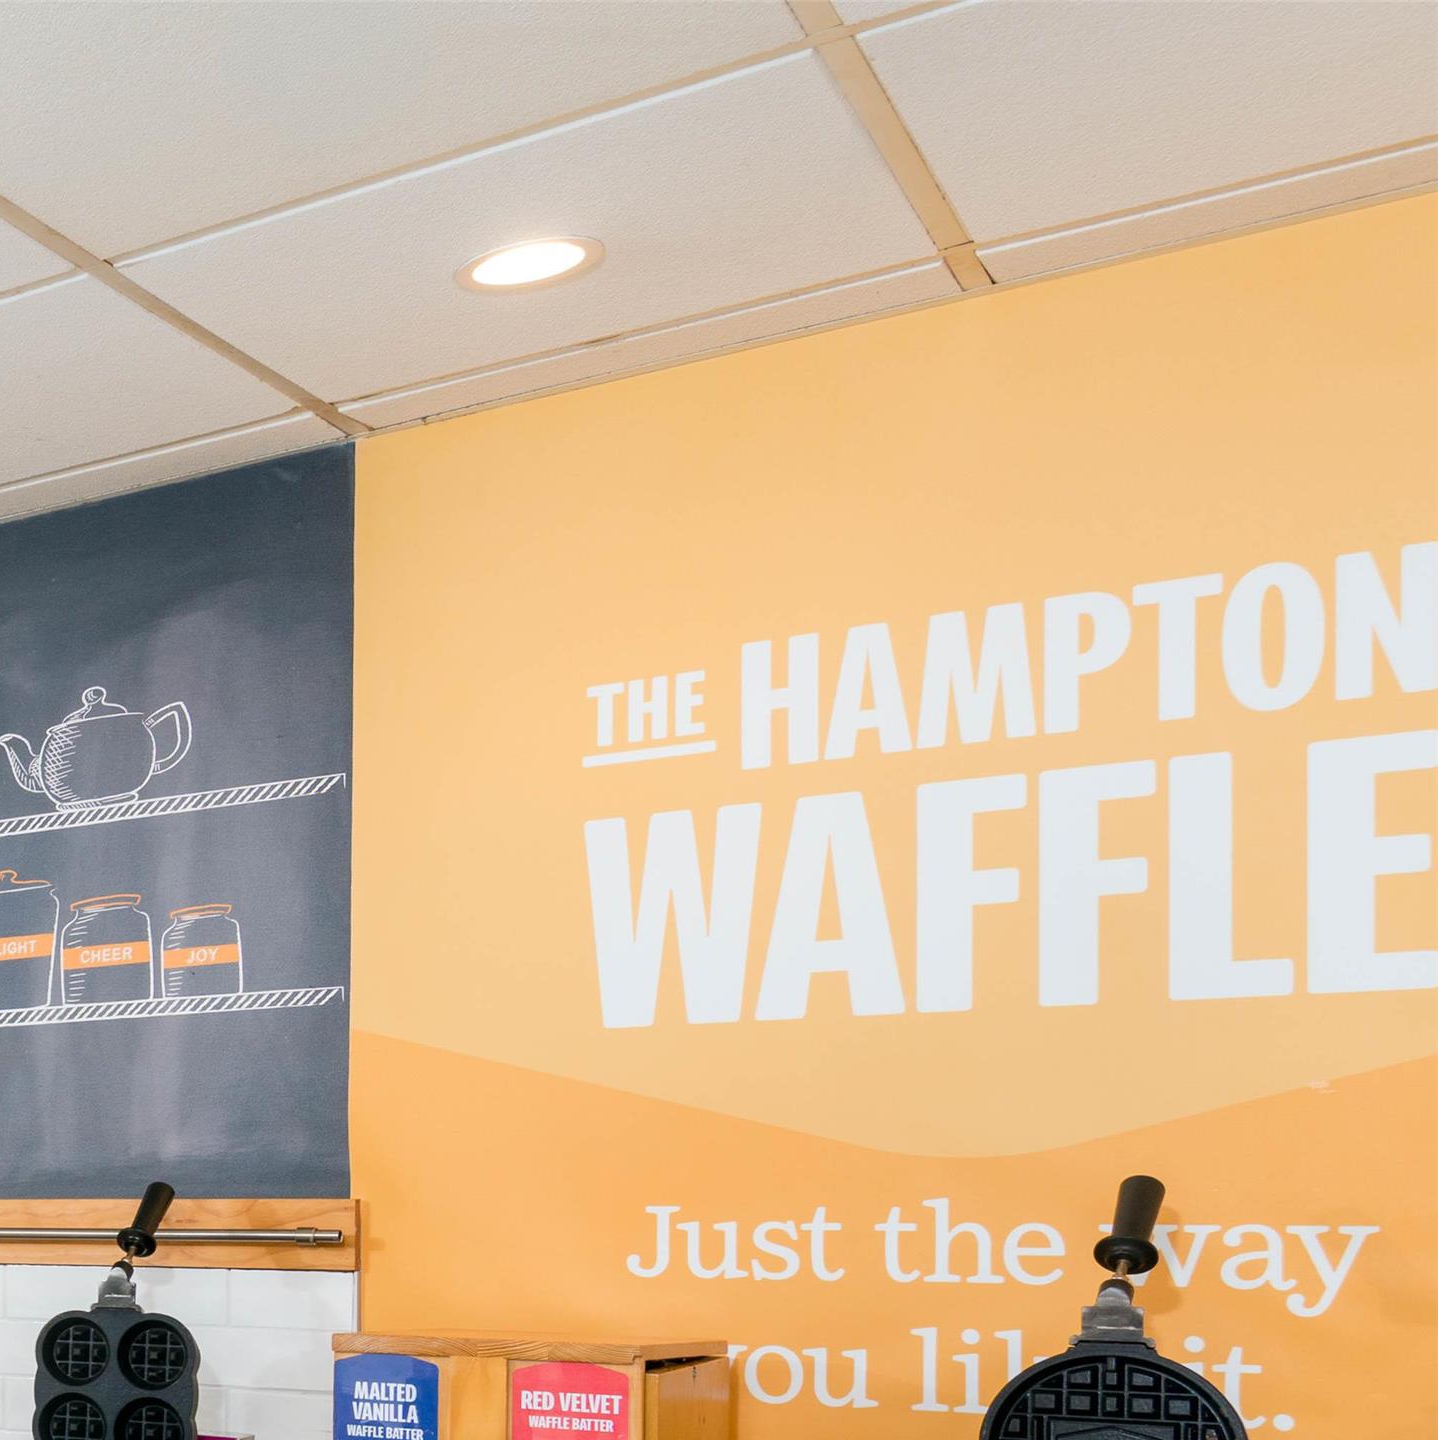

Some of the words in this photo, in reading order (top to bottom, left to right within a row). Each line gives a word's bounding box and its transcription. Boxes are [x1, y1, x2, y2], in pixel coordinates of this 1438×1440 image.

[586, 669, 707, 748] THE
[740, 540, 1438, 770] HAMPTON
[584, 728, 1438, 1029] WAFFLE
[80, 947, 133, 963] CHEER
[187, 948, 219, 963] JOY
[625, 1205, 846, 1283] Just
[874, 1197, 1066, 1286] the
[1098, 1222, 1381, 1318] way
[727, 1343, 879, 1409] ou
[353, 1380, 417, 1402] MALTED
[520, 1389, 555, 1411] RED
[558, 1391, 623, 1415] VELVET
[352, 1401, 419, 1424] VANILLA
[528, 1415, 570, 1430] WAFFLE
[571, 1417, 614, 1432] BATTER
[346, 1423, 384, 1438] WAFFLE
[385, 1426, 424, 1440] BATTER
